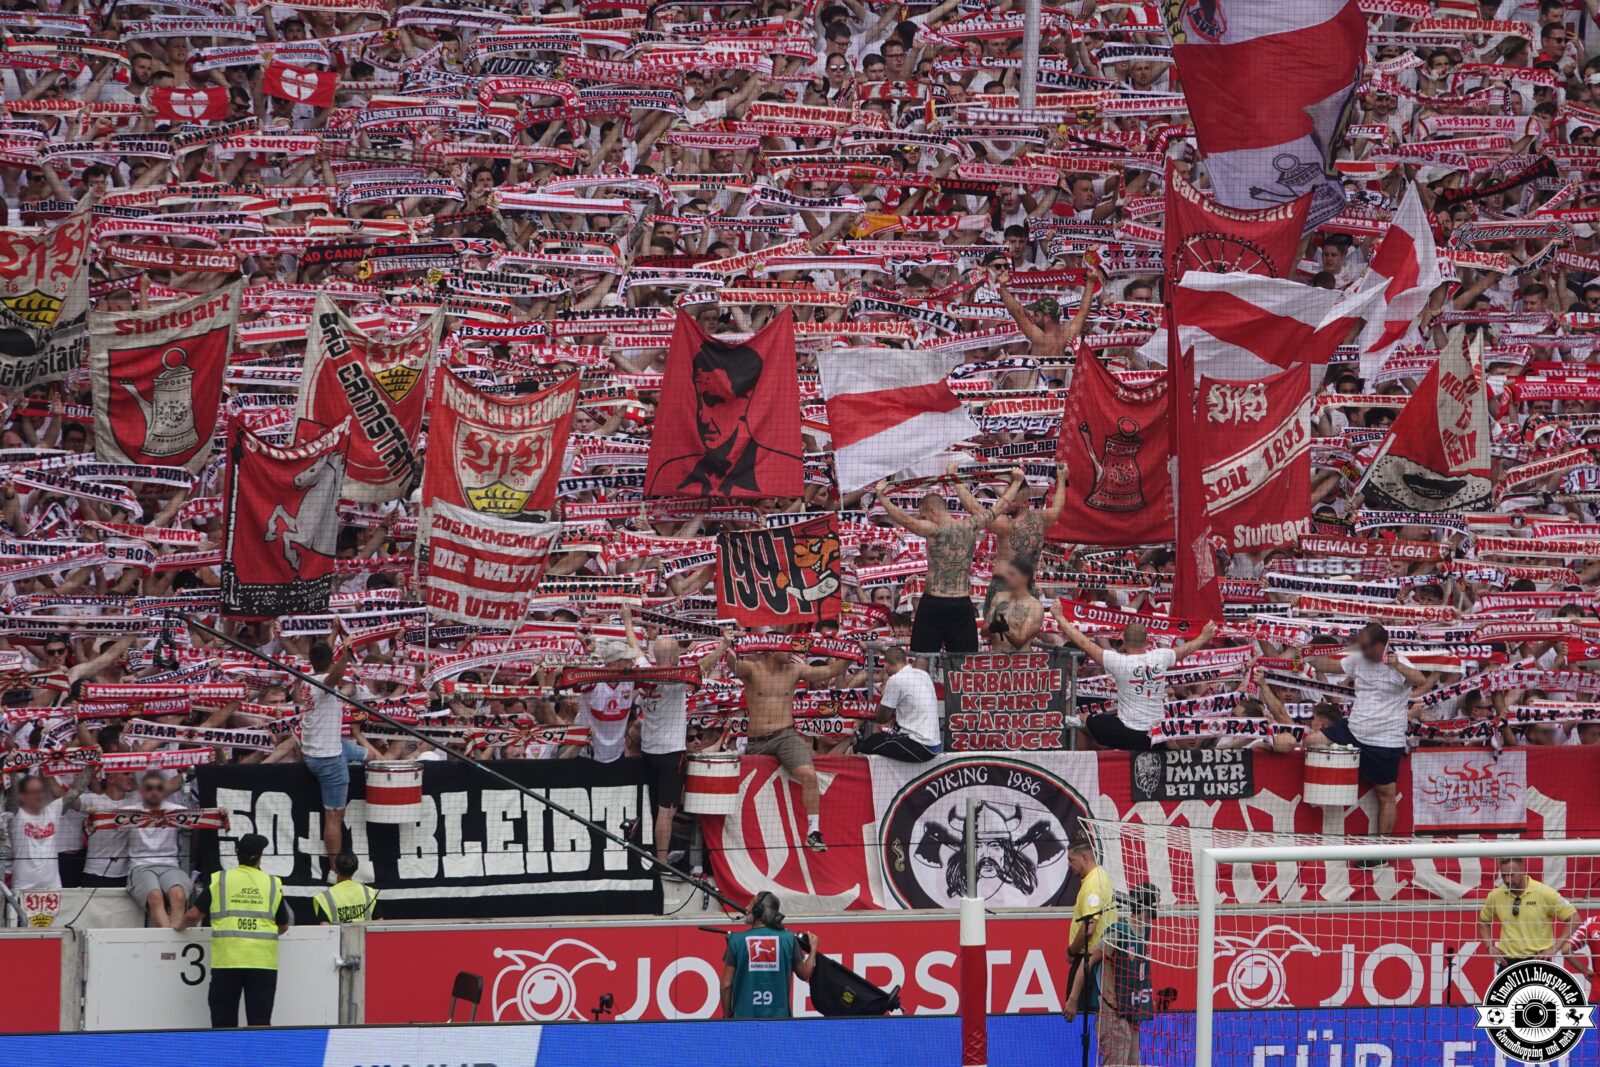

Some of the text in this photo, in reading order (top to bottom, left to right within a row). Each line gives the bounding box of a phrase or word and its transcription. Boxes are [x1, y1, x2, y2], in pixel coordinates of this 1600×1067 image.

[131, 20, 248, 35] SEKTION 0711
[672, 19, 771, 35] STUTTGART
[111, 245, 236, 267] NIEMALS 2. LIGA!
[114, 293, 230, 336] Stuttgart
[441, 380, 576, 427] Neckarstadion
[1260, 417, 1306, 472] 1893
[25, 468, 124, 499] STUTTGART
[159, 529, 202, 542] KURVE
[1233, 517, 1313, 547] Stuttgart
[1302, 539, 1431, 558] NIEMALS 2. LIGA!
[433, 546, 468, 574] DIE
[1075, 603, 1169, 631] Commando
[961, 654, 1050, 673] JEDER
[947, 669, 1063, 694] VERBANNTE
[960, 692, 1052, 712] KEHRT
[204, 729, 272, 747] STADION
[541, 731, 566, 742] 97
[950, 727, 1063, 752] ZURÜCK
[1165, 748, 1245, 764] DU BIST
[926, 766, 1041, 799] VIKING 1986
[1165, 763, 1247, 783] IMMER
[1165, 780, 1247, 798] BEI UNS!
[175, 813, 201, 825] 97
[337, 903, 367, 922] SECURITY
[237, 917, 258, 931] 0695
[180, 943, 207, 986] 3
[752, 990, 774, 1006] 29
